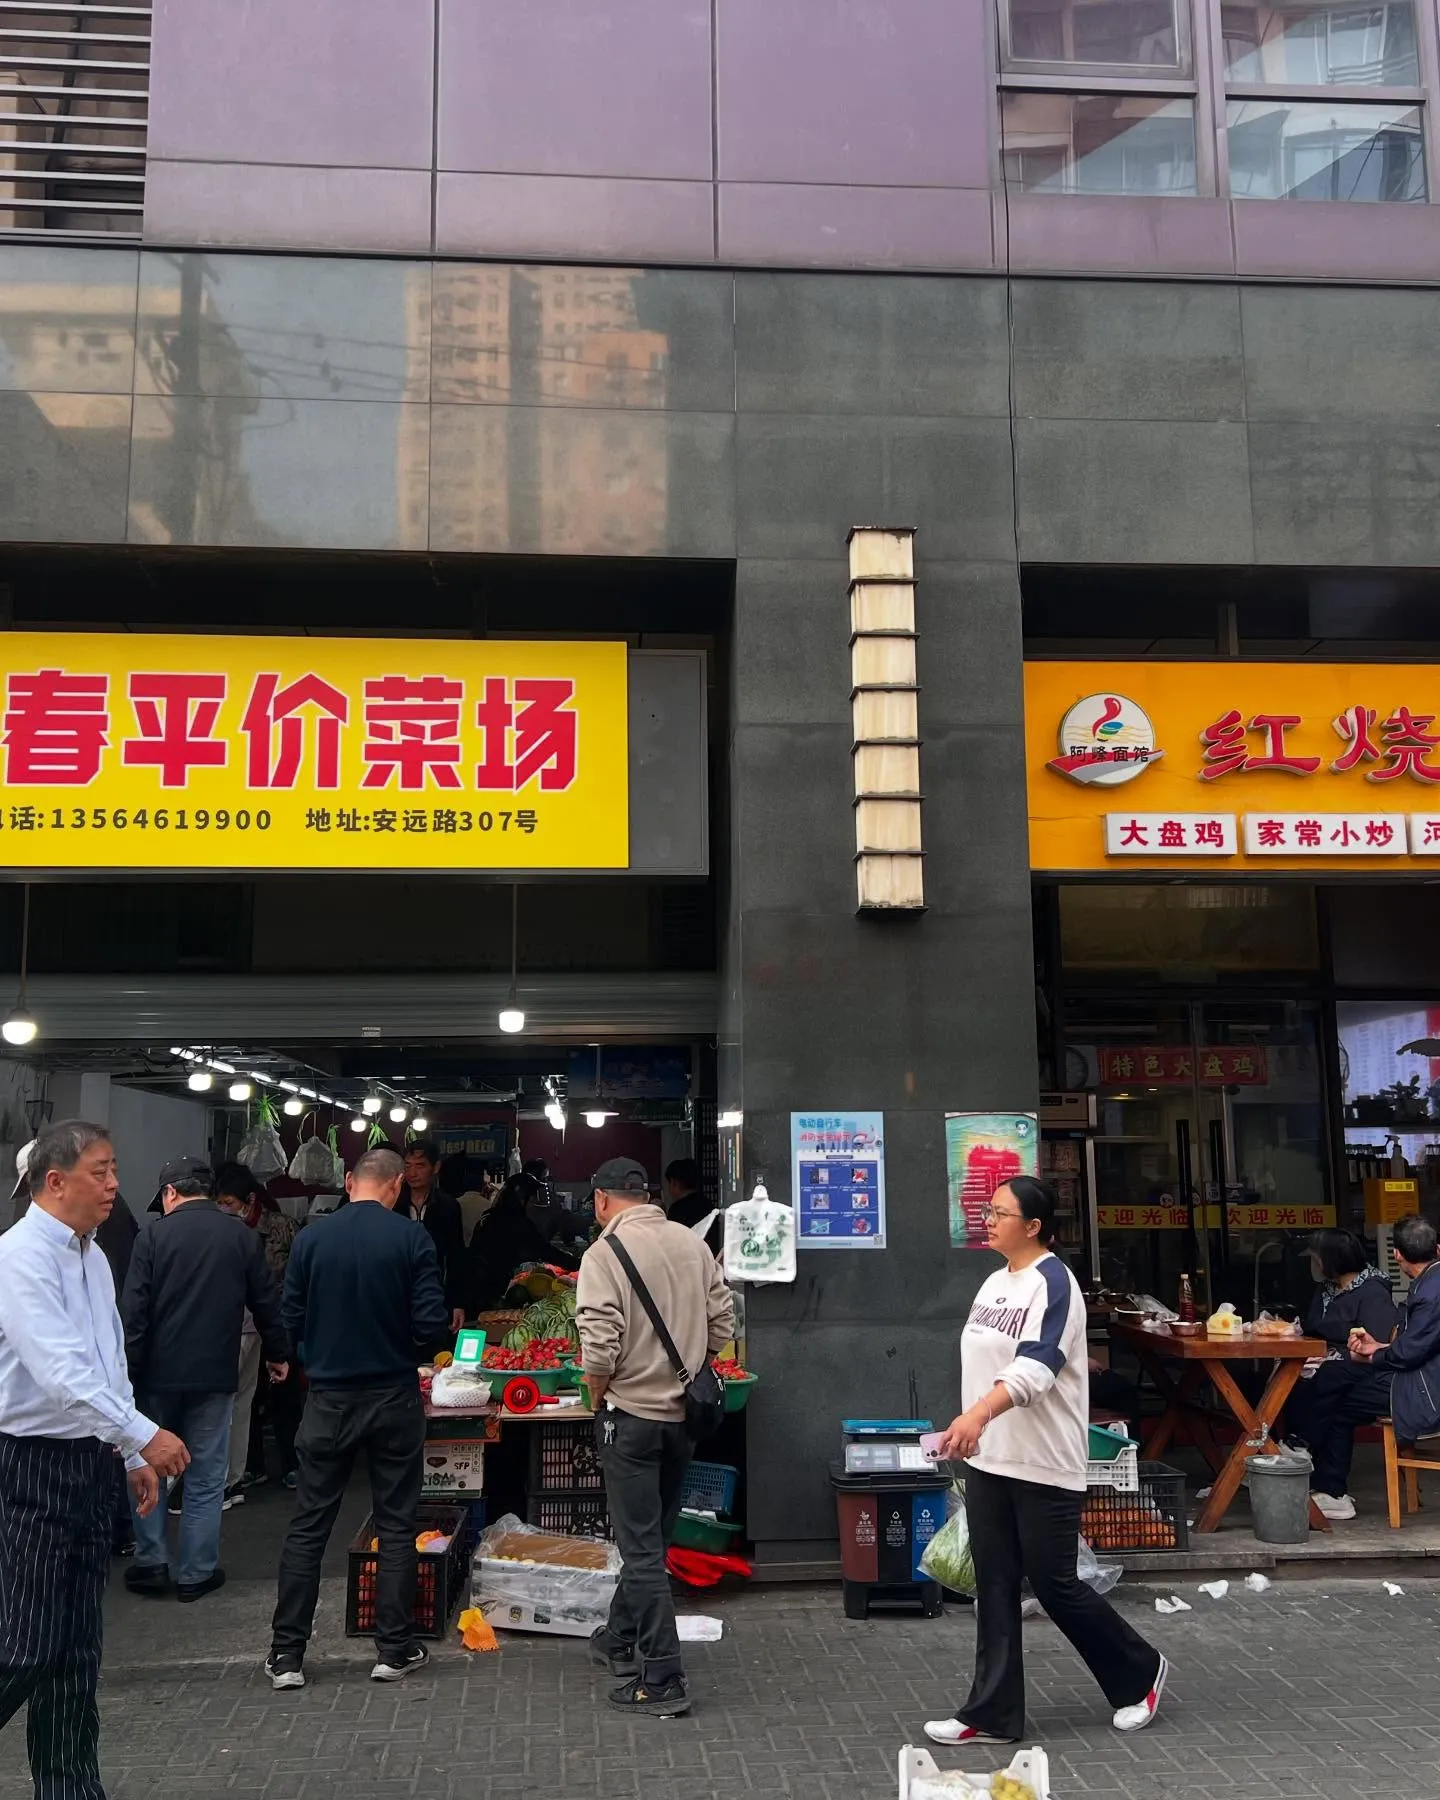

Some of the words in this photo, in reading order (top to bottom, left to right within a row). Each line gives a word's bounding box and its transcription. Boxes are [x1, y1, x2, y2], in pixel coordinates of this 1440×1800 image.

[1, 669, 577, 791] 春平价菜场
[0, 805, 272, 832] 话:13564619900
[305, 807, 538, 833] 地址:安远路307号
[1119, 819, 1225, 847] 大盘鸡
[1257, 819, 1394, 847] 家常小炒
